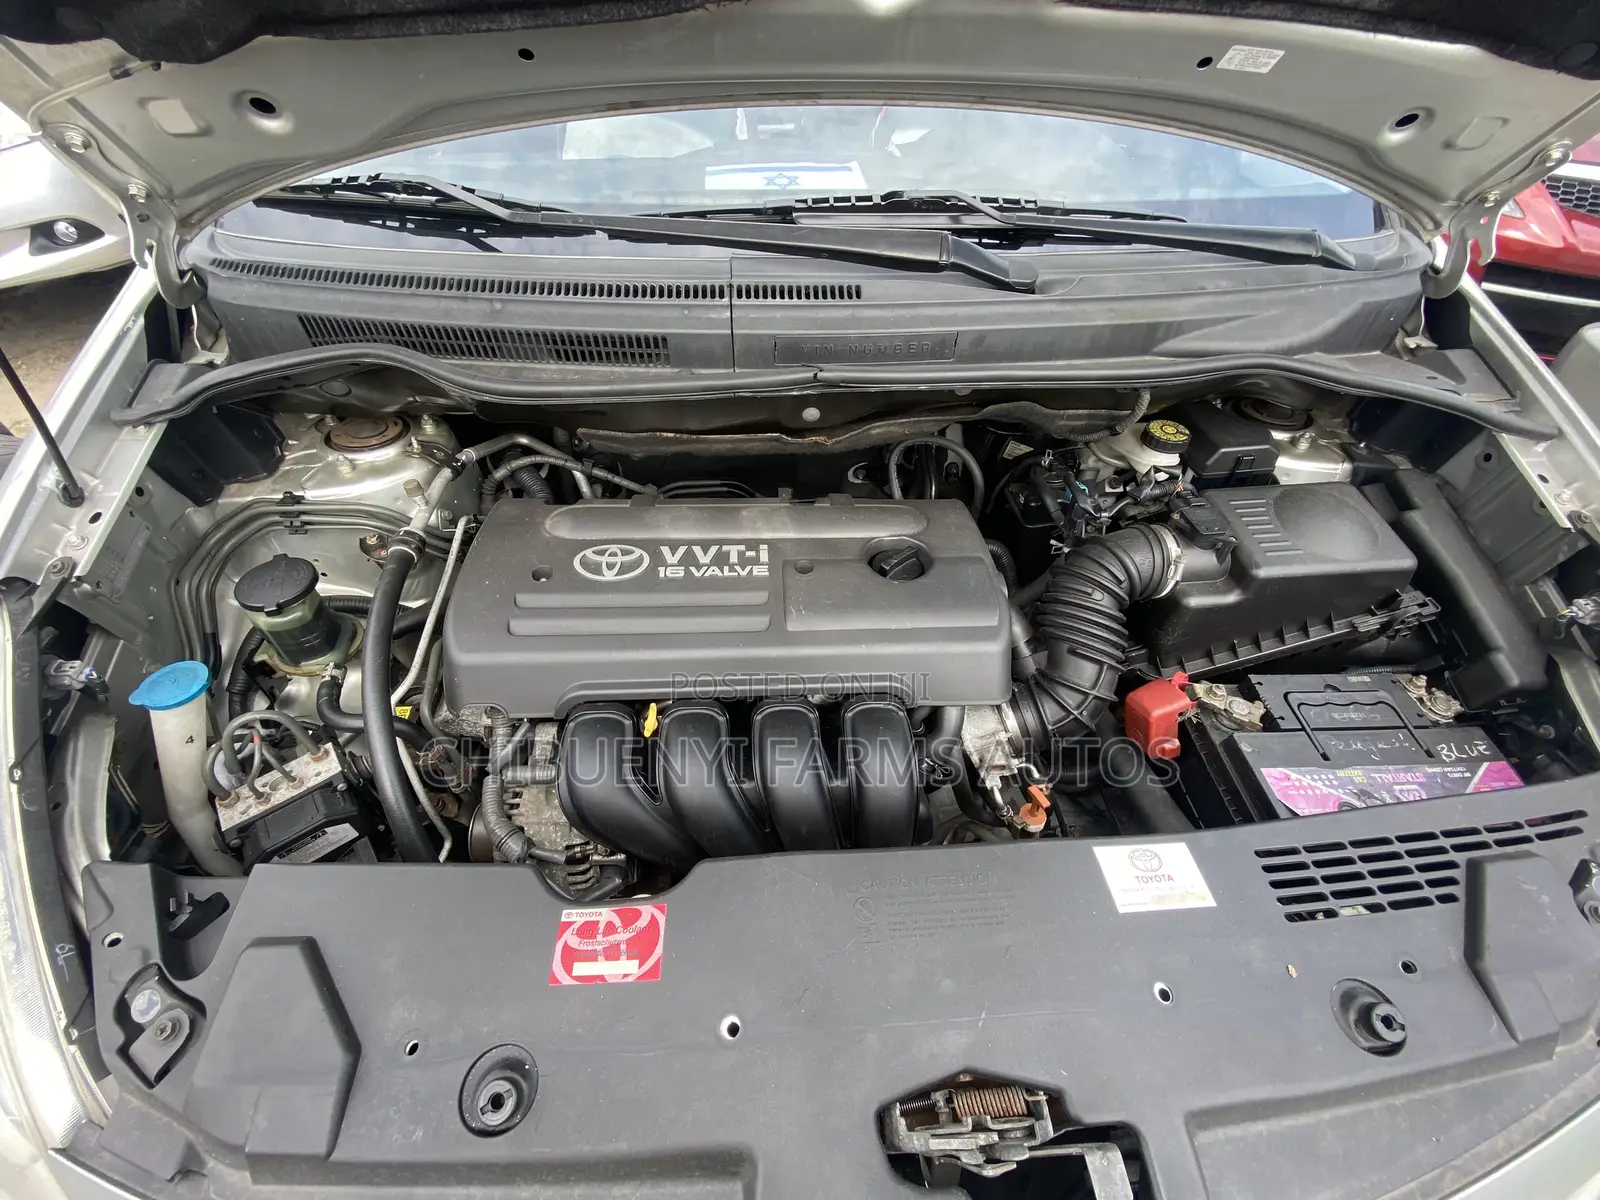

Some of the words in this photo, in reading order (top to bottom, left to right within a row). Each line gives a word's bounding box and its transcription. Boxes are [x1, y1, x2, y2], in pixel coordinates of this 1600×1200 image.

[800, 343, 834, 356] VIN
[848, 340, 932, 355] NUMBER
[659, 544, 769, 565] VVT-i
[657, 566, 686, 578] 16
[689, 565, 770, 577] VALVE
[185, 735, 195, 744] 4
[1435, 741, 1491, 763] BLUE
[1134, 873, 1175, 885] TOYOTA
[574, 911, 603, 919] TOYOTA
[616, 924, 652, 936] Coolant
